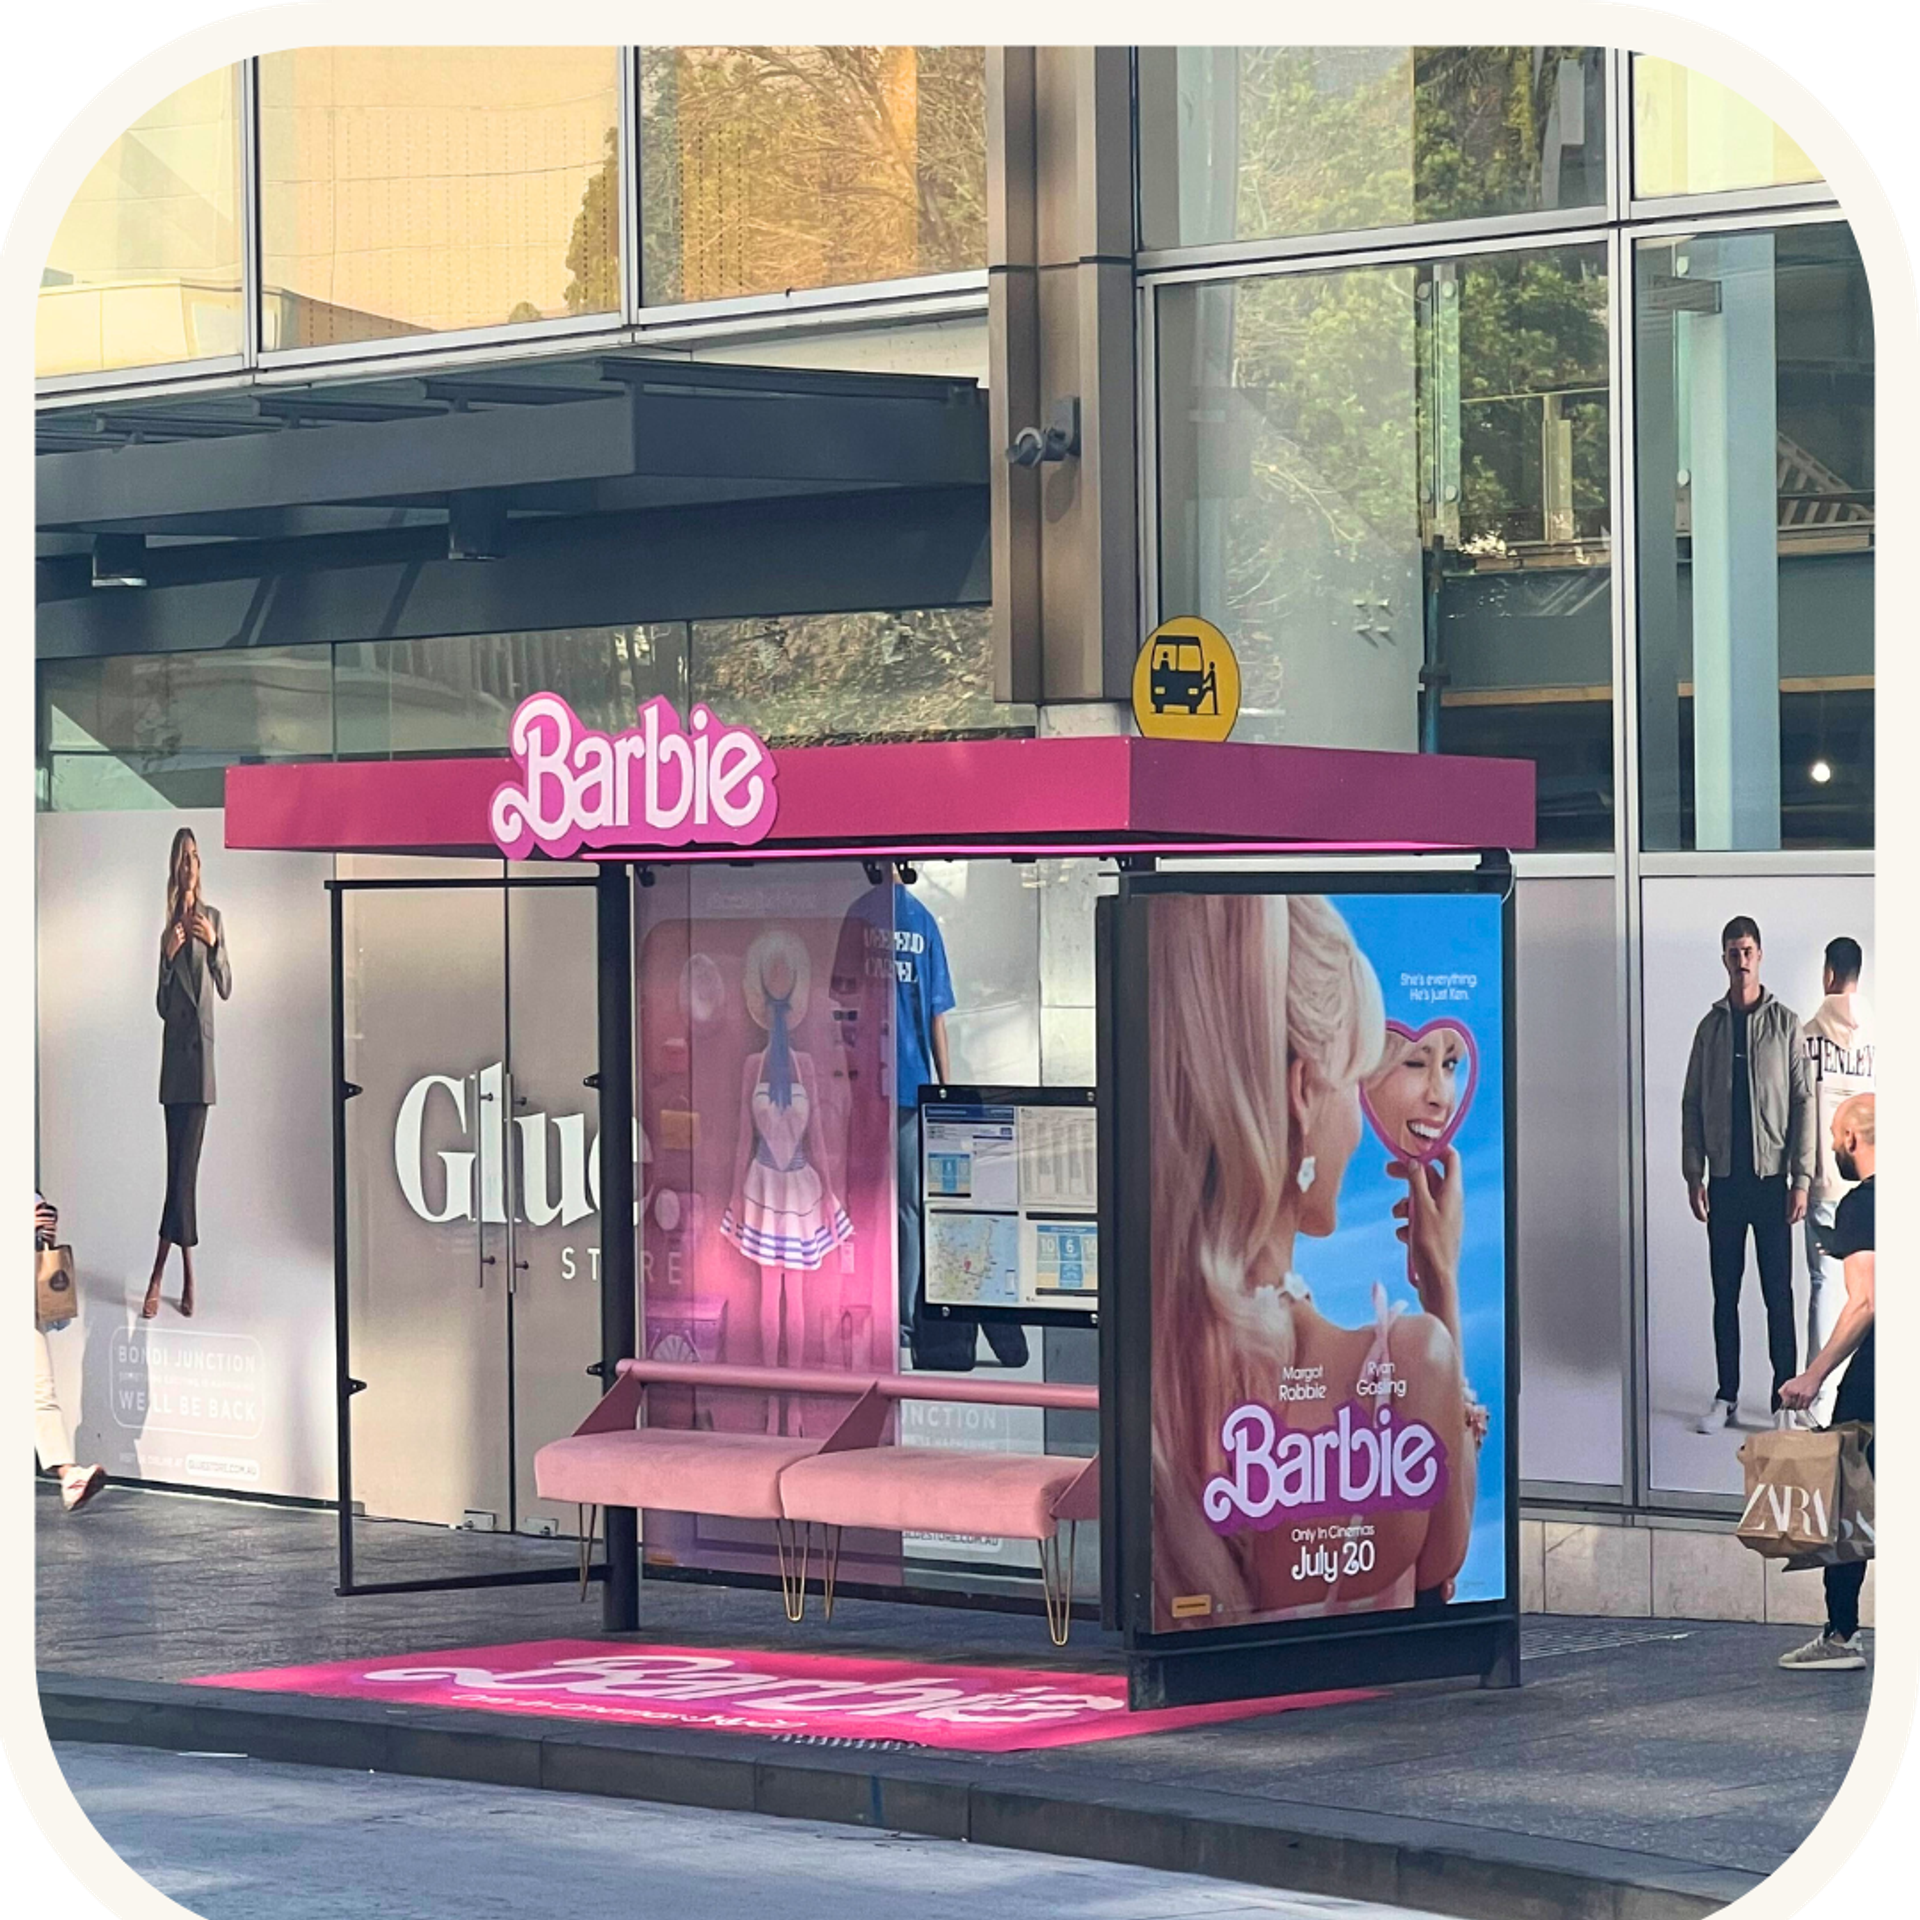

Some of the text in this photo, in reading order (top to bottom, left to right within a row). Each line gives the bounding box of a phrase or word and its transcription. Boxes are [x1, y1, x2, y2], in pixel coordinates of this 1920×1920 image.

[491, 698, 765, 844] Barbie
[1065, 1239, 1075, 1253] 6
[561, 1247, 682, 1285] STRE
[118, 1345, 257, 1374] BONDI JUNCTION
[1366, 1361, 1395, 1377] Ryan
[1282, 1366, 1324, 1384] Margot
[1356, 1378, 1406, 1398] Gosling
[118, 1389, 257, 1423] WELL BE BACK
[1279, 1385, 1327, 1400] Robbie
[1203, 1404, 1438, 1522] Barbie
[1736, 1483, 1829, 1538] ZARA
[1291, 1530, 1317, 1544] Only
[1328, 1524, 1375, 1541] Cinemas
[1291, 1540, 1375, 1583] July 20
